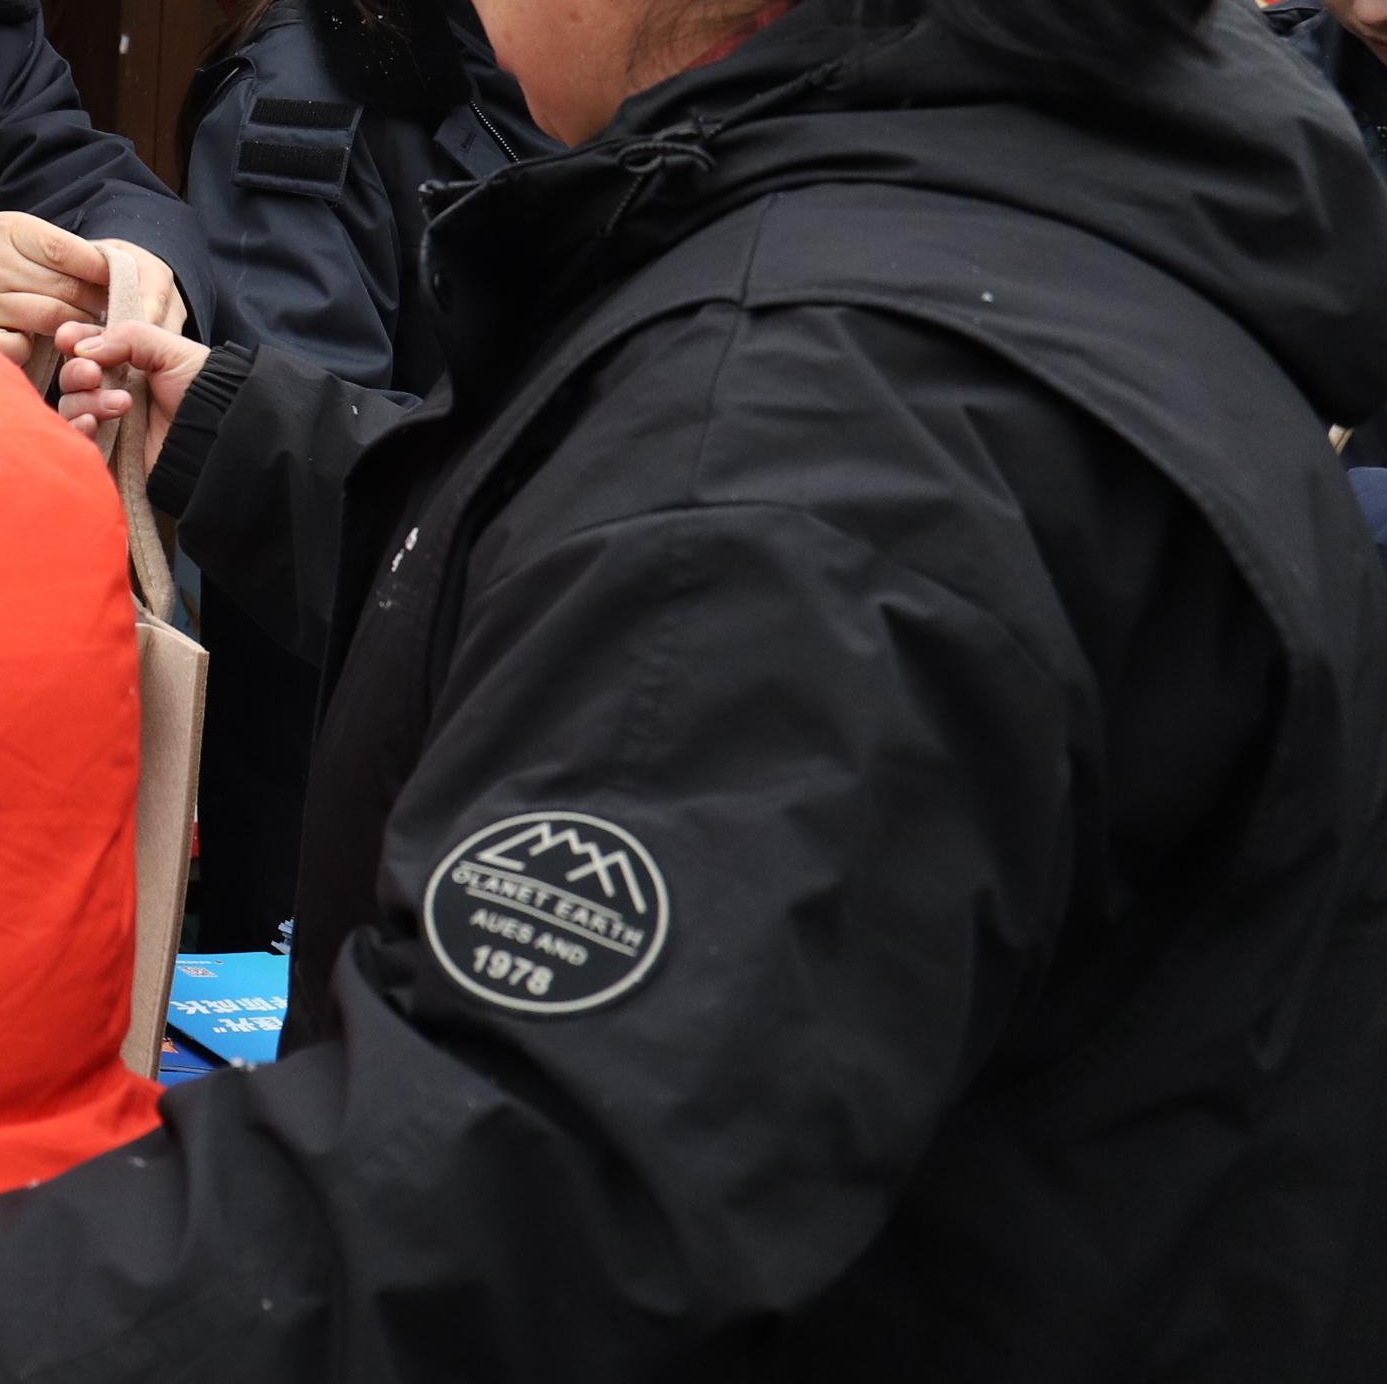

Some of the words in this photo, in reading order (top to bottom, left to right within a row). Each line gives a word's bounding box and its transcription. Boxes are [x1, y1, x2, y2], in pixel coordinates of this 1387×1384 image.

[554, 898, 645, 947] EARTH
[473, 944, 554, 996] 1978
[534, 932, 588, 966] AND
